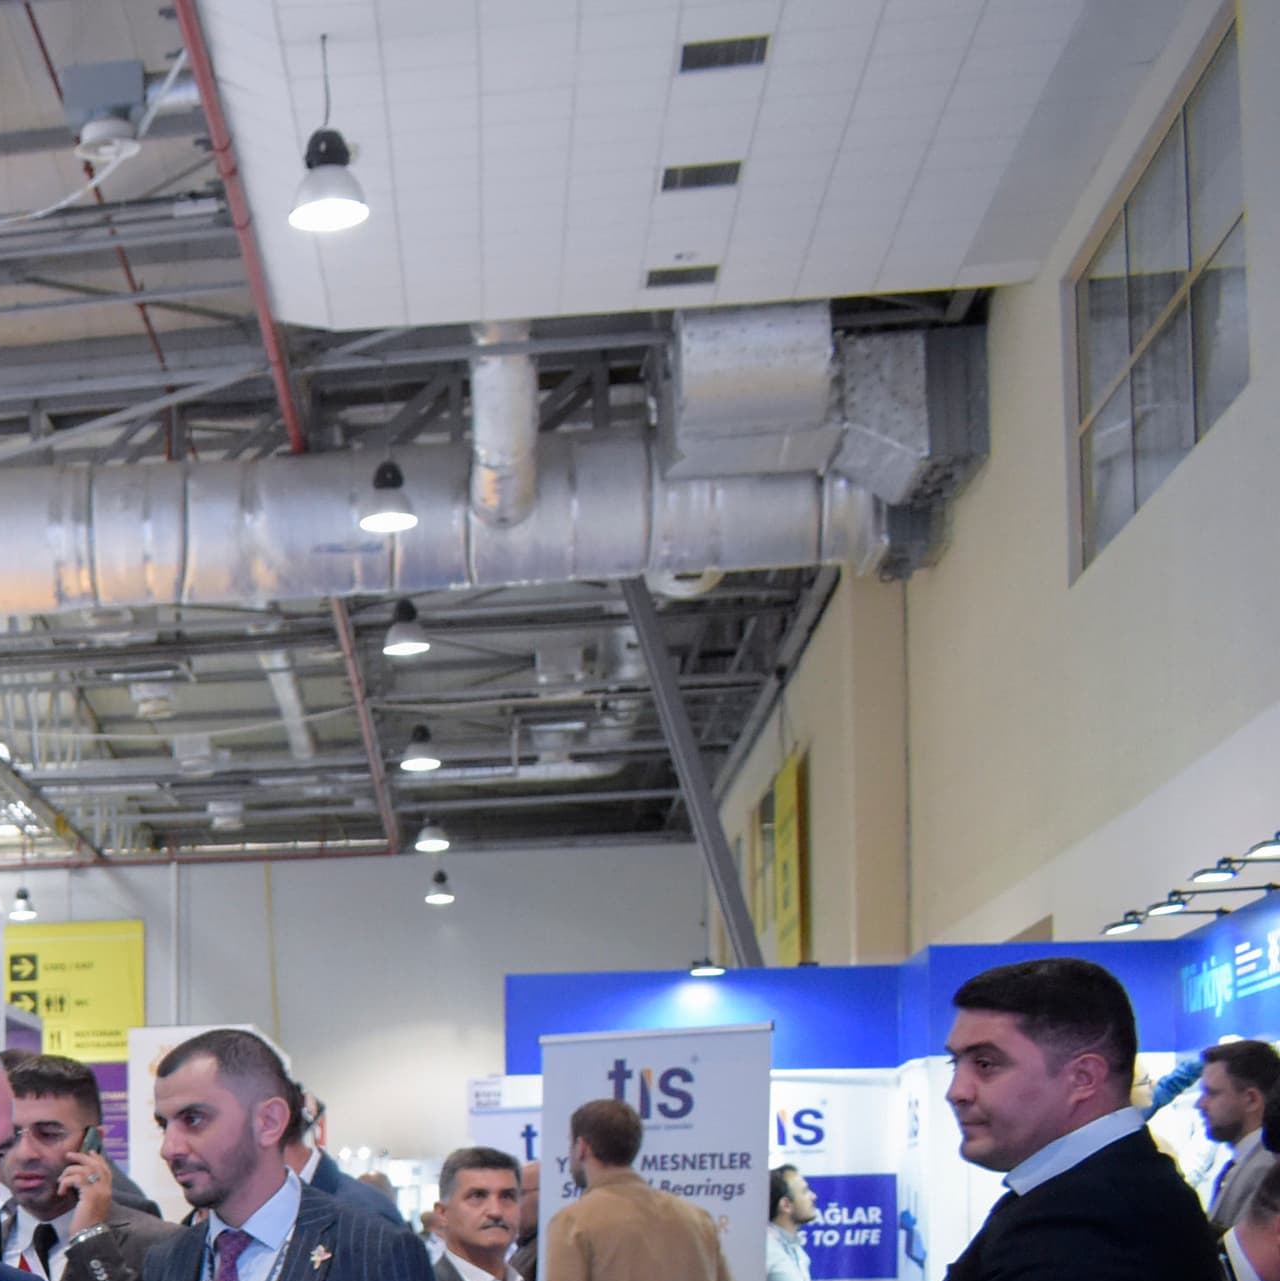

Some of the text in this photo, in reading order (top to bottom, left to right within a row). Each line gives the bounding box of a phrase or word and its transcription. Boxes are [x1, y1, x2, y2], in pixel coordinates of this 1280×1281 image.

[640, 1151, 752, 1172] MESNETLER
[659, 1177, 746, 1201] Bearings
[807, 1202, 883, 1226] AĞLAR
[812, 1229, 840, 1248] TO
[844, 1228, 881, 1247] LIFE
